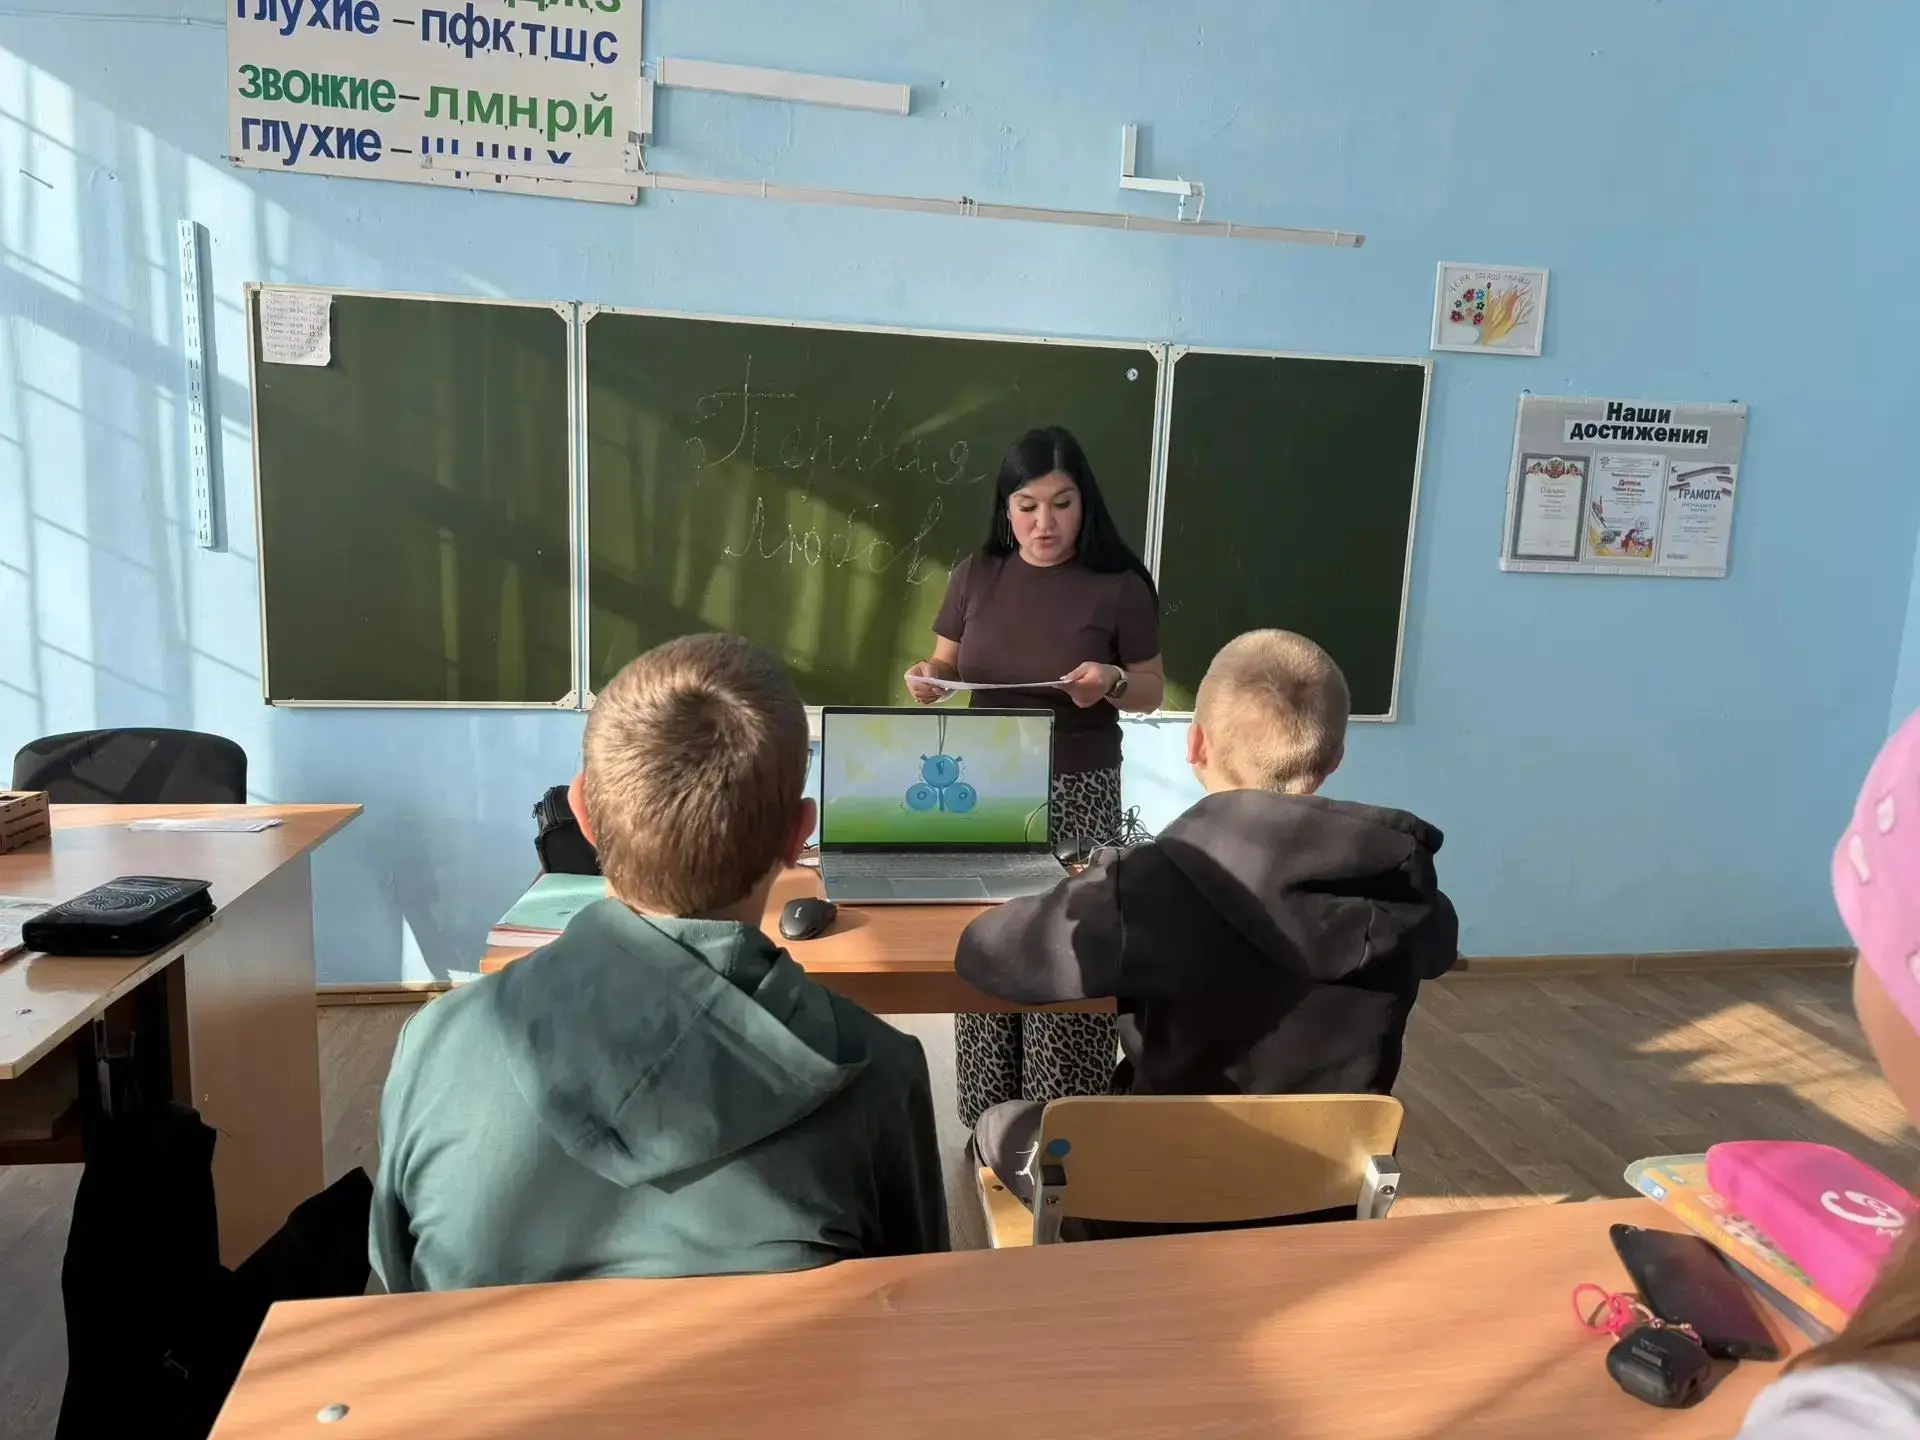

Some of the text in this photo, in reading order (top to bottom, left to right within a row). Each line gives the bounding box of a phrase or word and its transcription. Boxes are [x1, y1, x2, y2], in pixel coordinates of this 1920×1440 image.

[237, 64, 396, 113] звонкие
[241, 117, 382, 165] глухие
[1606, 402, 1672, 424] Наши
[1678, 487, 1721, 501] ГРАМОТА
